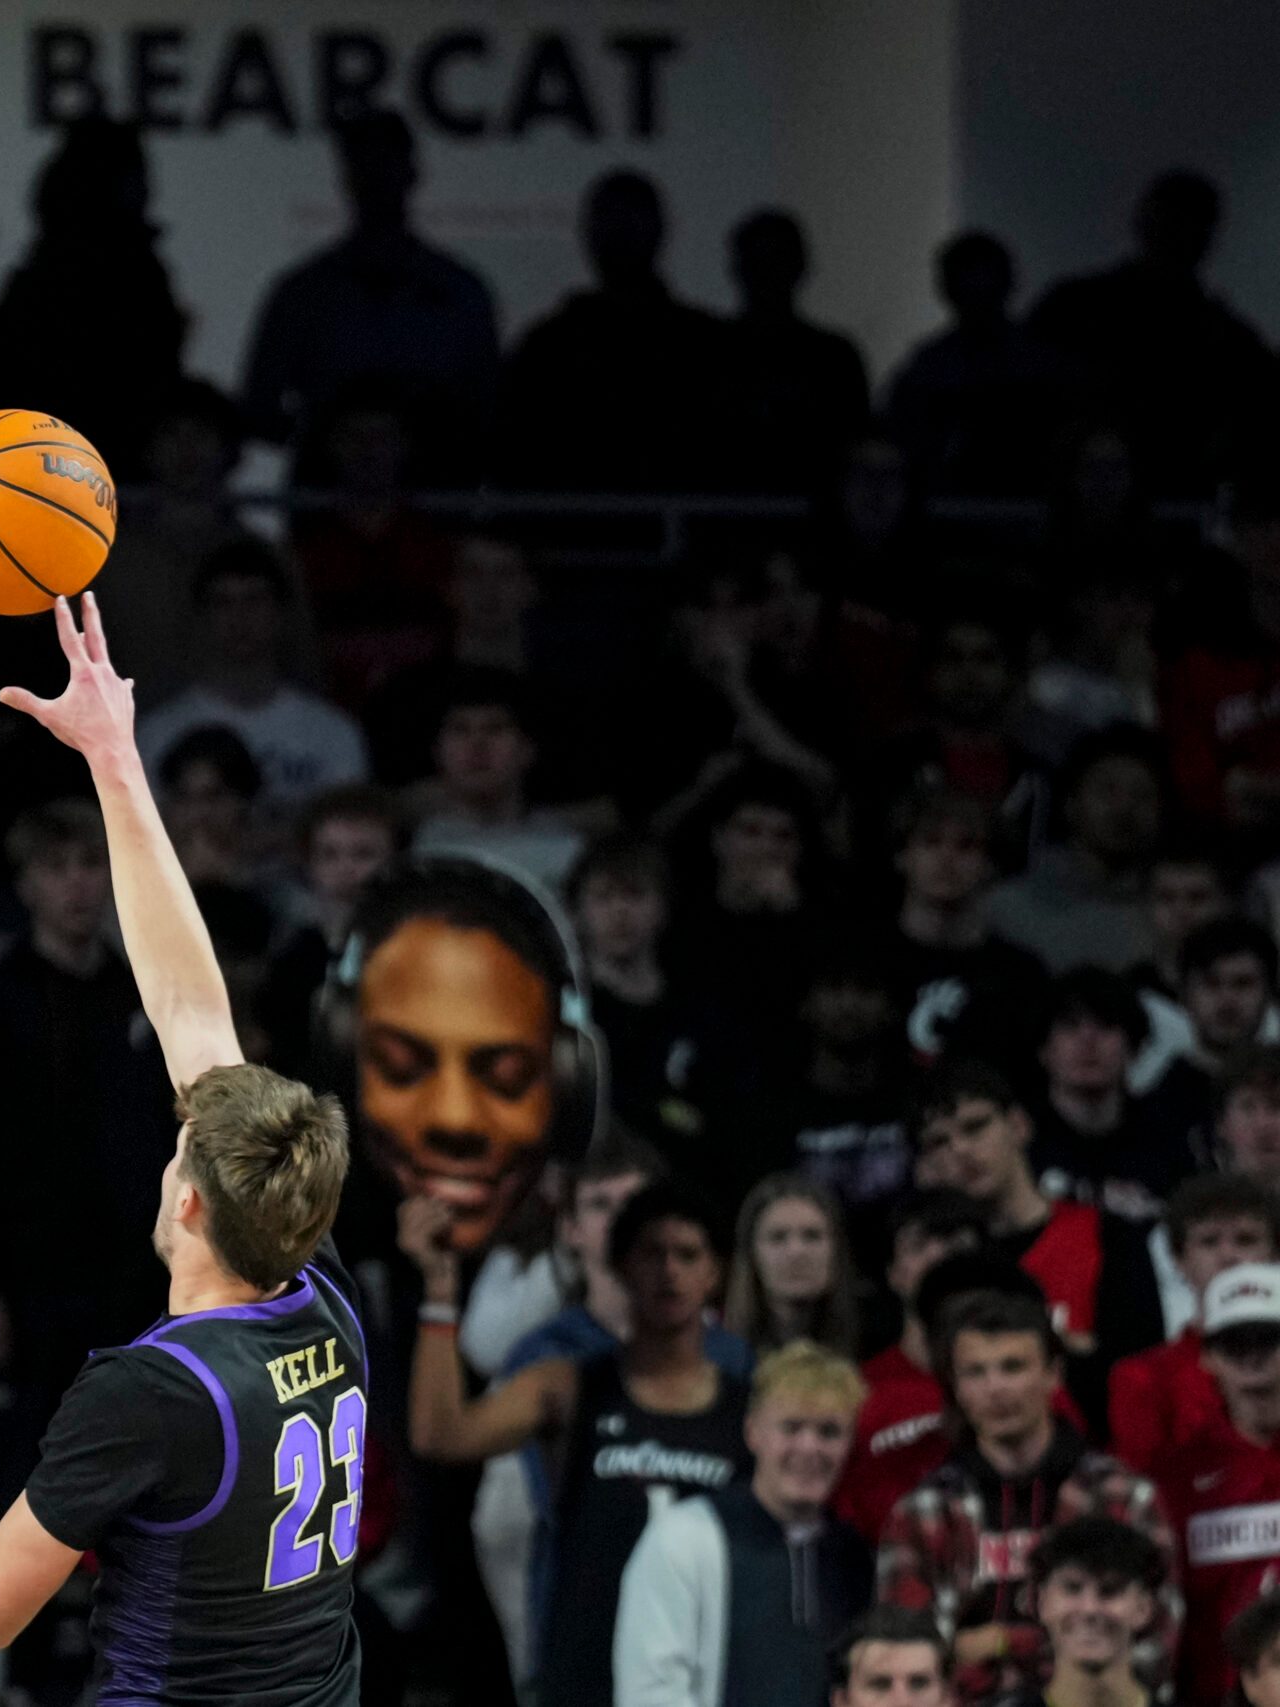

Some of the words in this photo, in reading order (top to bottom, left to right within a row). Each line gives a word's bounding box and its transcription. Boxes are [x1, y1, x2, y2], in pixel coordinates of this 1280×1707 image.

[30, 26, 680, 139] BEARCAT
[266, 1337, 345, 1404] KELL
[263, 1386, 367, 1592] 23
